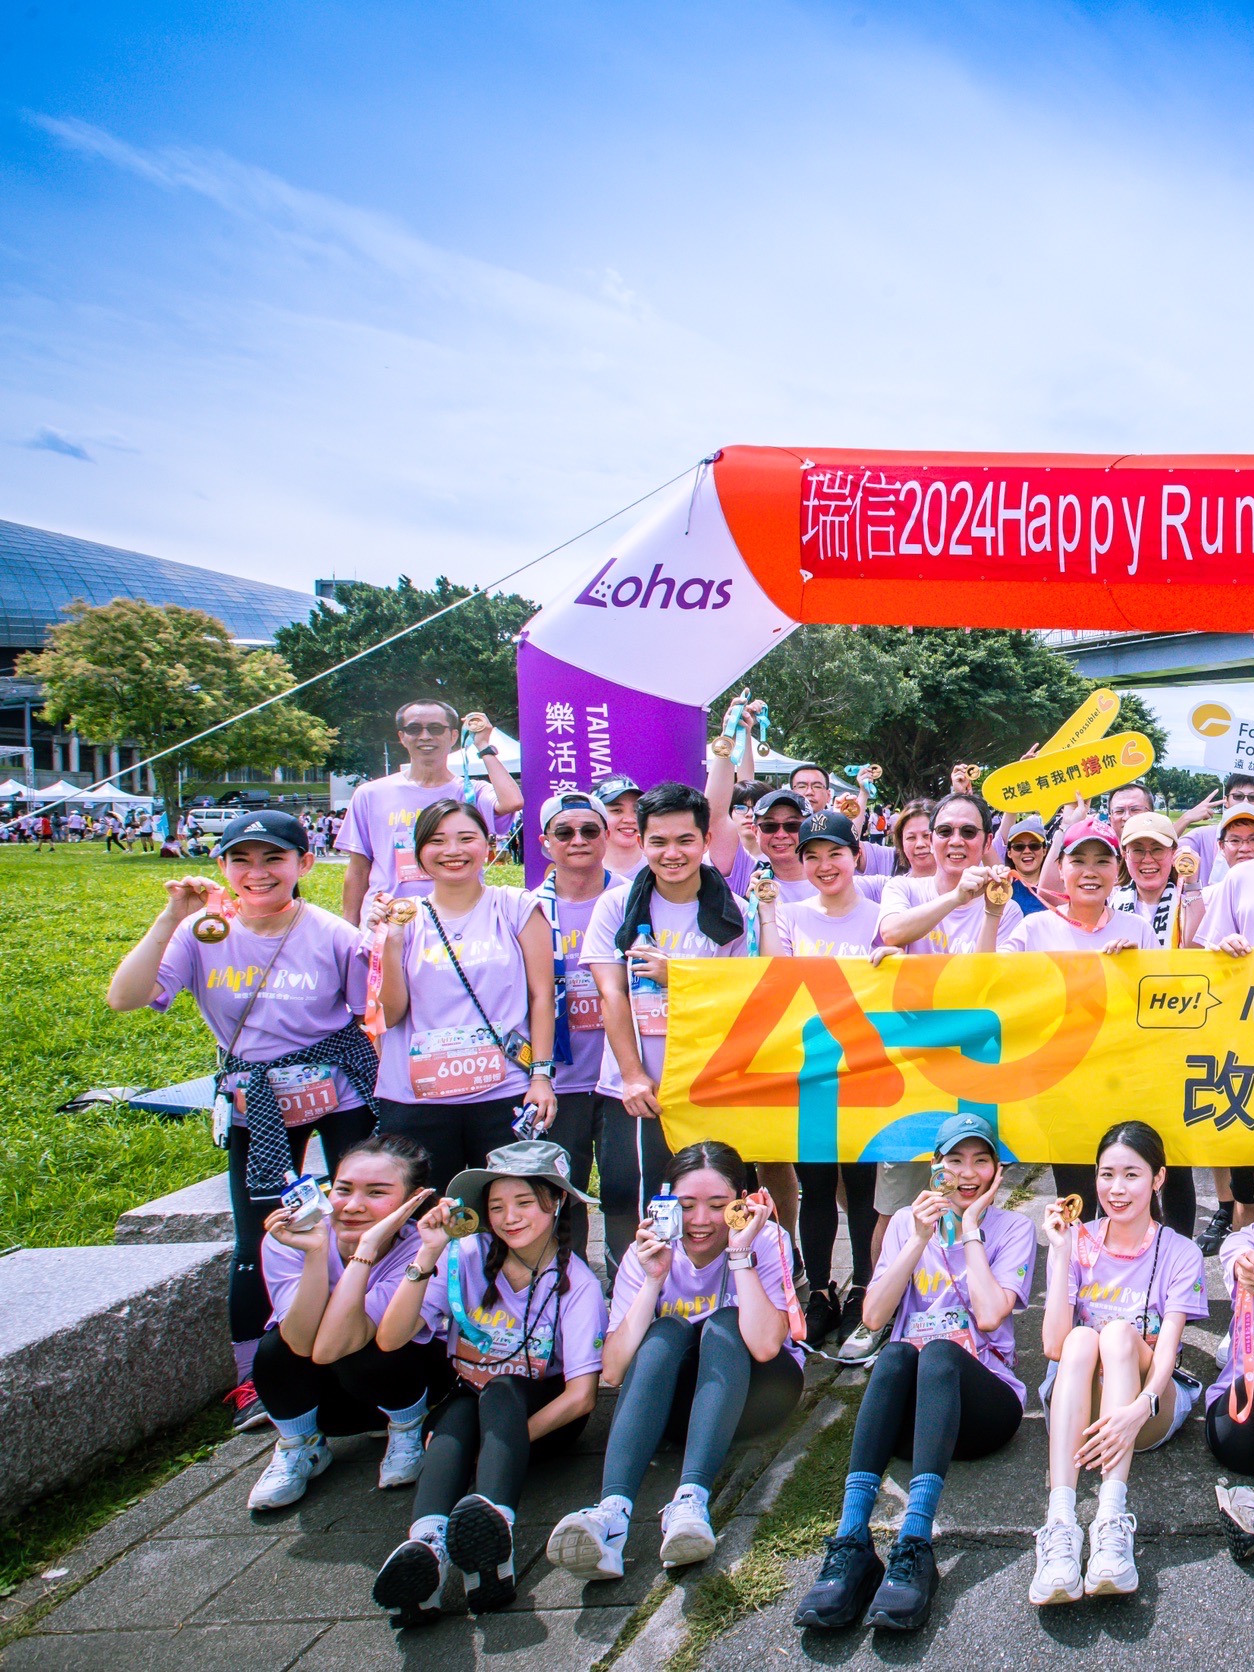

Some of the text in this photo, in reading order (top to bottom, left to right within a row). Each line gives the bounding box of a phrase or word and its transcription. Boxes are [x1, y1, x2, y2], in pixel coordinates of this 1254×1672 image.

[574, 557, 733, 610] Lohas
[1002, 754, 1118, 801] 改變 有我們撐你
[1149, 991, 1201, 1012] Hey!
[437, 1054, 501, 1078] 60094
[661, 1293, 717, 1319] HAPPY
